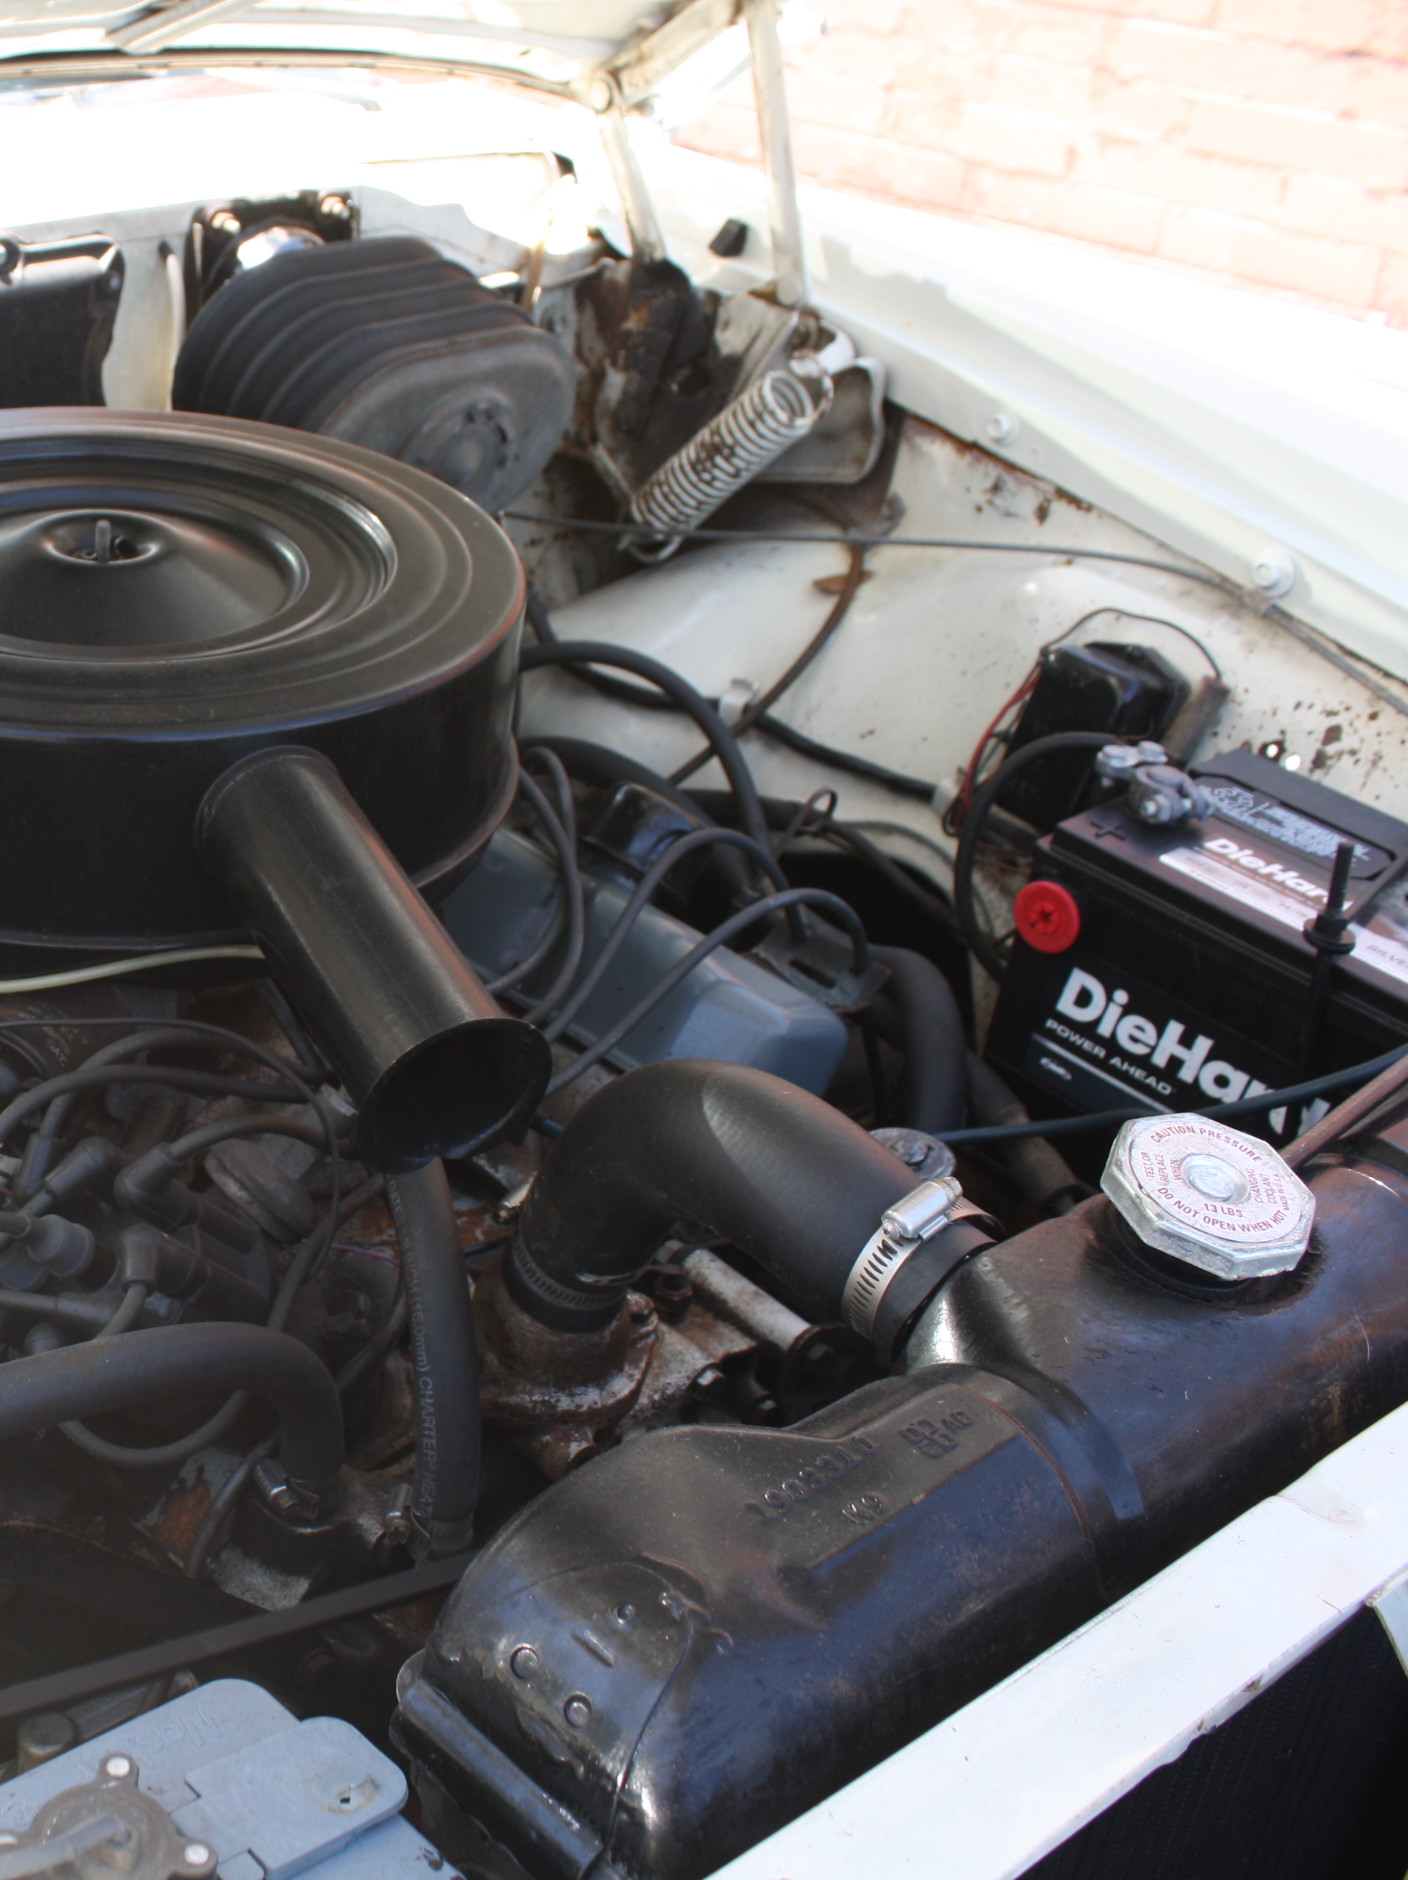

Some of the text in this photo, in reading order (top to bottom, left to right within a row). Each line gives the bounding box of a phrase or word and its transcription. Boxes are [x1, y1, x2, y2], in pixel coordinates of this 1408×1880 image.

[1045, 1018, 1106, 1060] POWER
[1108, 1056, 1173, 1096] AHEAD
[1150, 1125, 1263, 1162] CAUTION PRESSURE
[1154, 1153, 1169, 1186] REPLACE
[1157, 1187, 1289, 1233] DO NOT OPEN WHEN HOT
[1203, 1203, 1218, 1213] 13
[419, 1469, 437, 1517] HEAT
